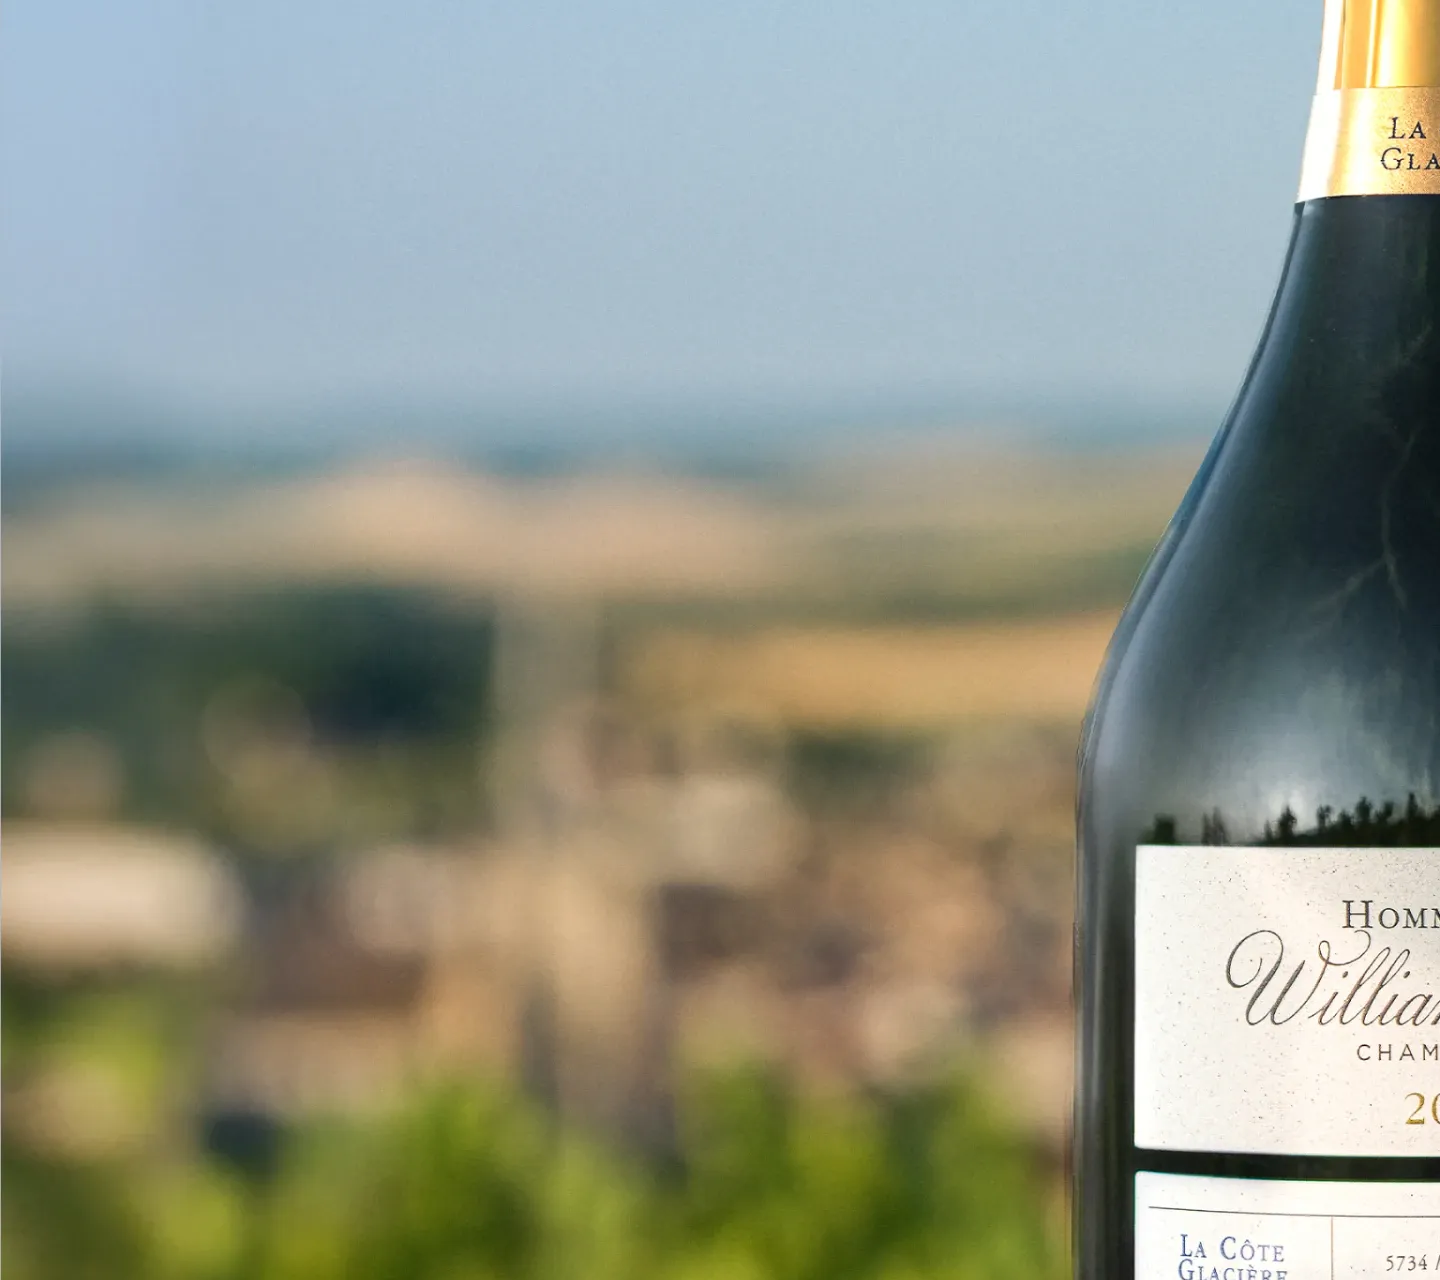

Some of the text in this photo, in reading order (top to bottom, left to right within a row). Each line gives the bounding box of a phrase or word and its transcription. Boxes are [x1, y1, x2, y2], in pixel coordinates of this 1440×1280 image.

[1388, 116, 1427, 140] LA
[1180, 1234, 1285, 1263] LA CÔTE
[1385, 1255, 1428, 1272] 5734
